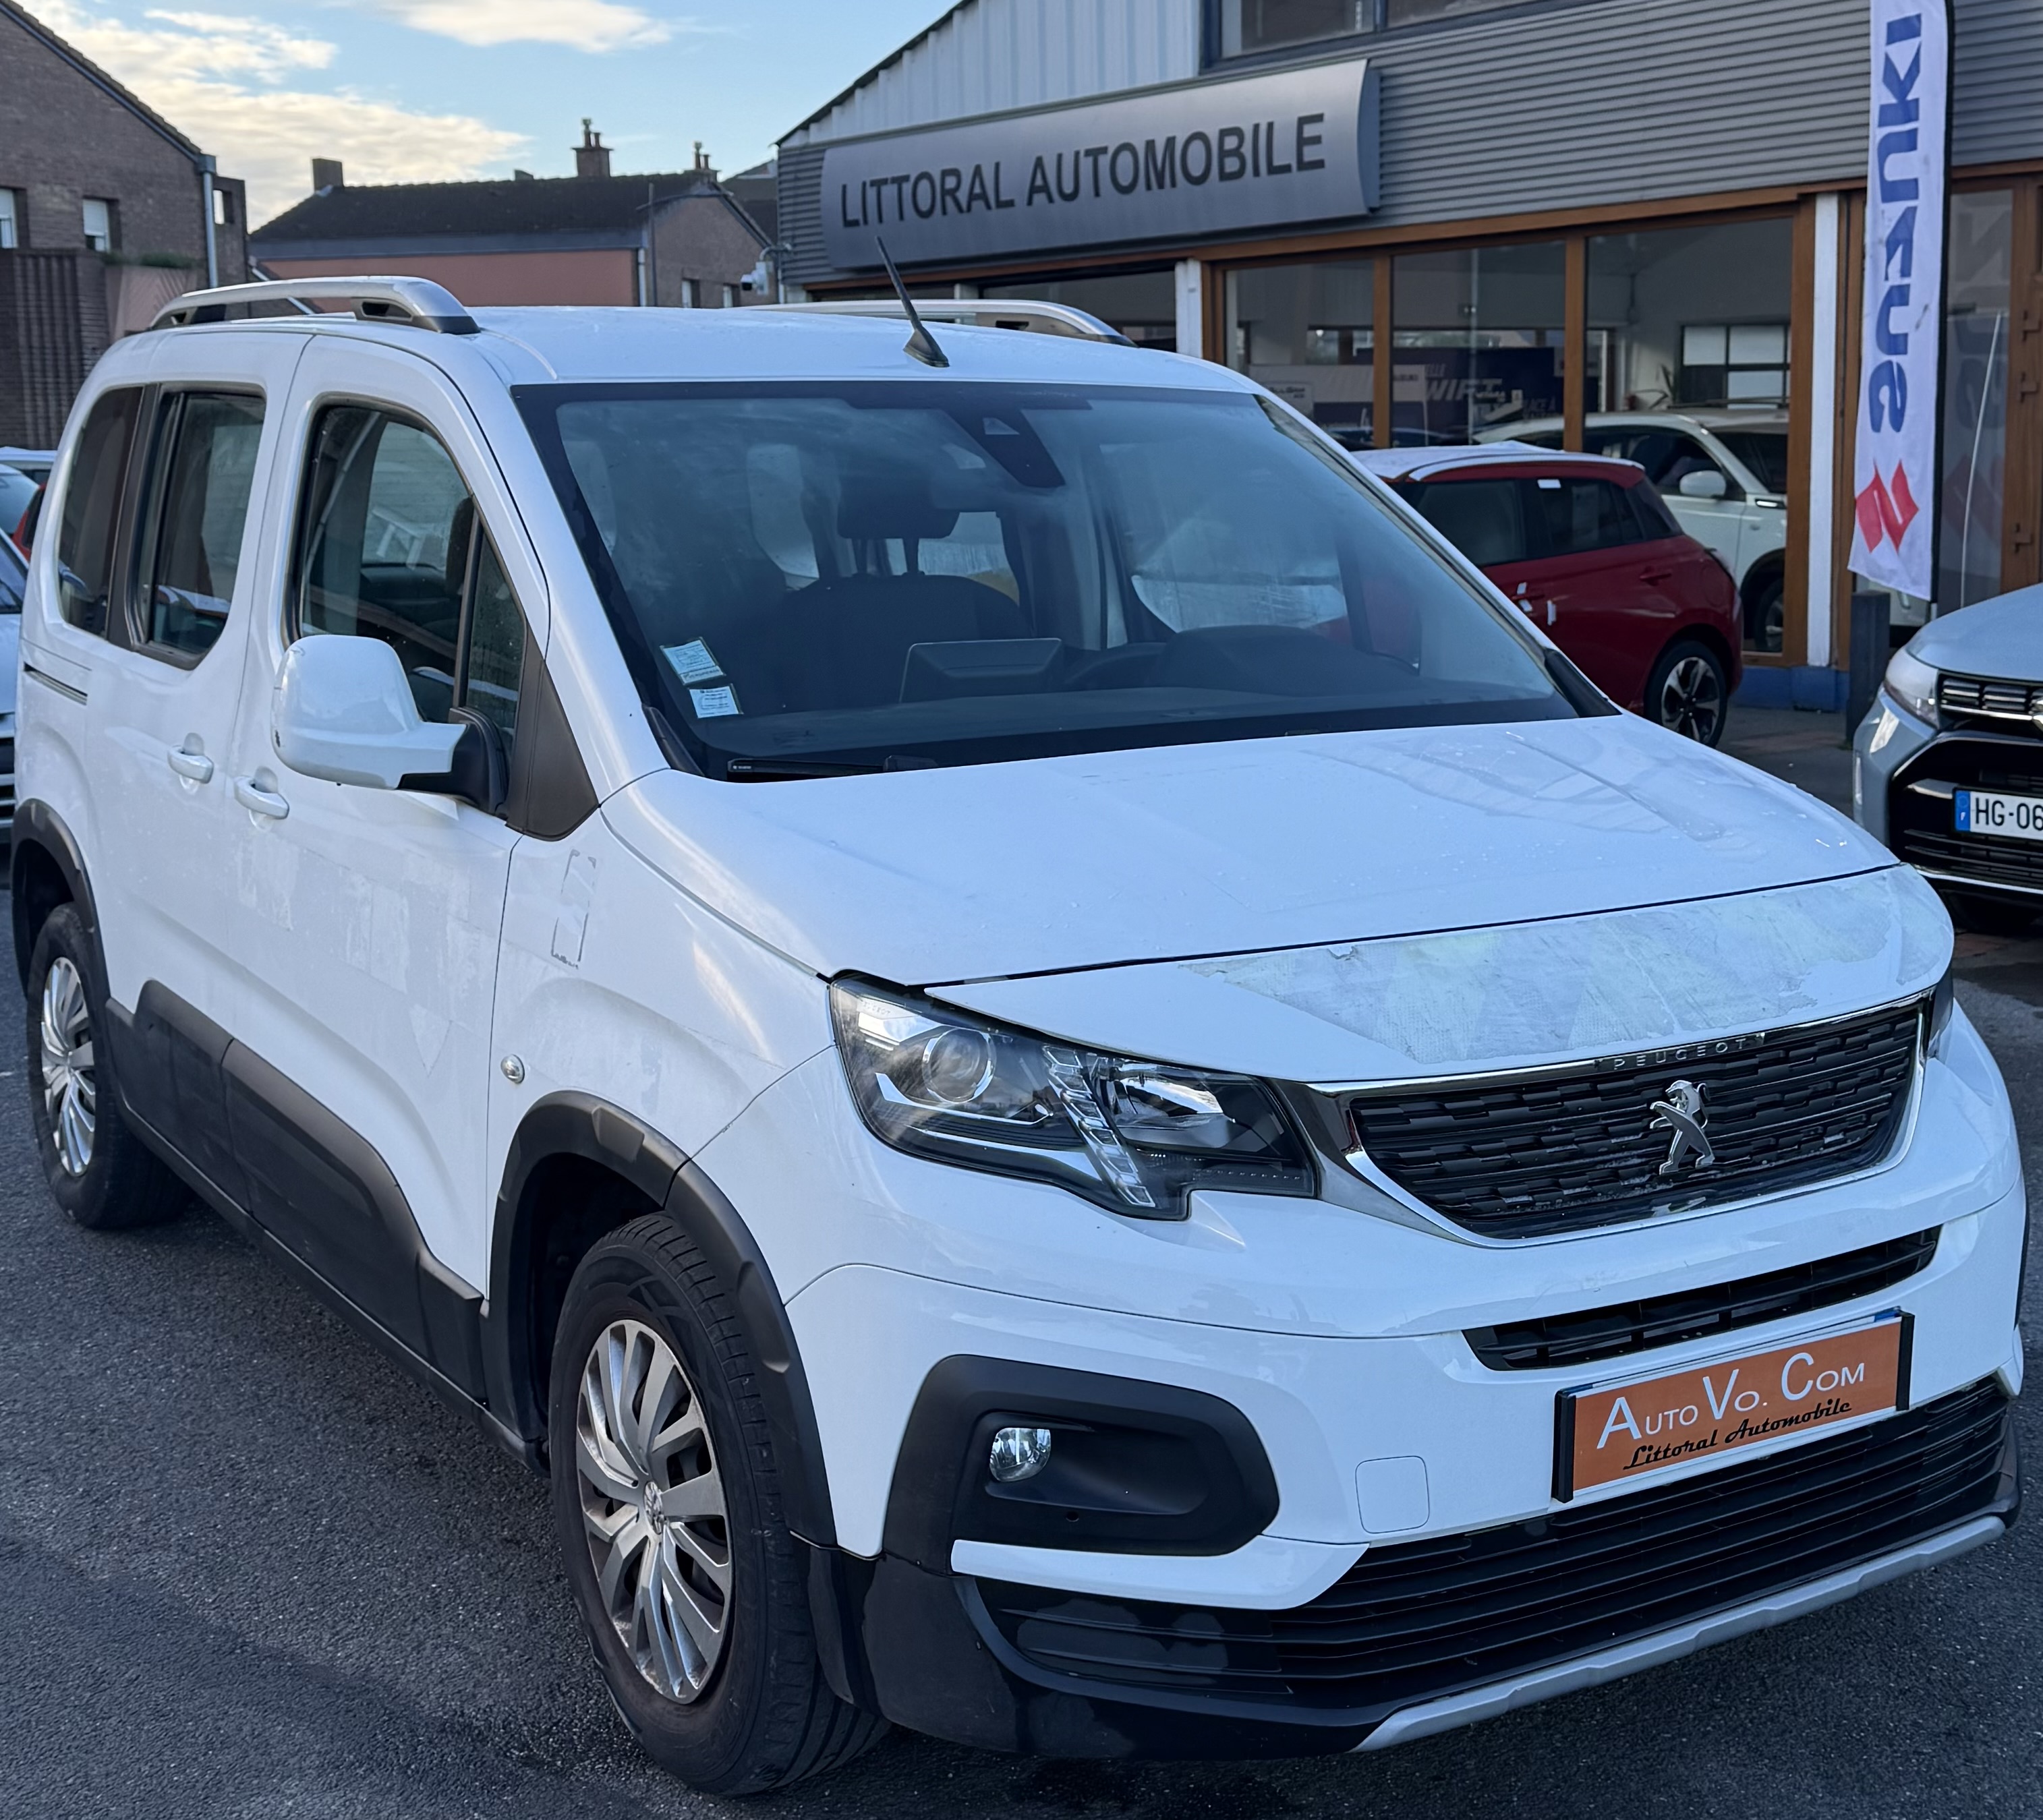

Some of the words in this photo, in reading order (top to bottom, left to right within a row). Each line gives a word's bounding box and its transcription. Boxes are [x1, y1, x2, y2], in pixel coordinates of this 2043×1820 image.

[840, 161, 1015, 229] LITTORAL
[1026, 113, 1326, 207] AUTOMOBILE
[1614, 1038, 1746, 1070] PEUGEOT
[1623, 1429, 1719, 1470] Littoral
[1724, 1398, 1852, 1444] Automobile
